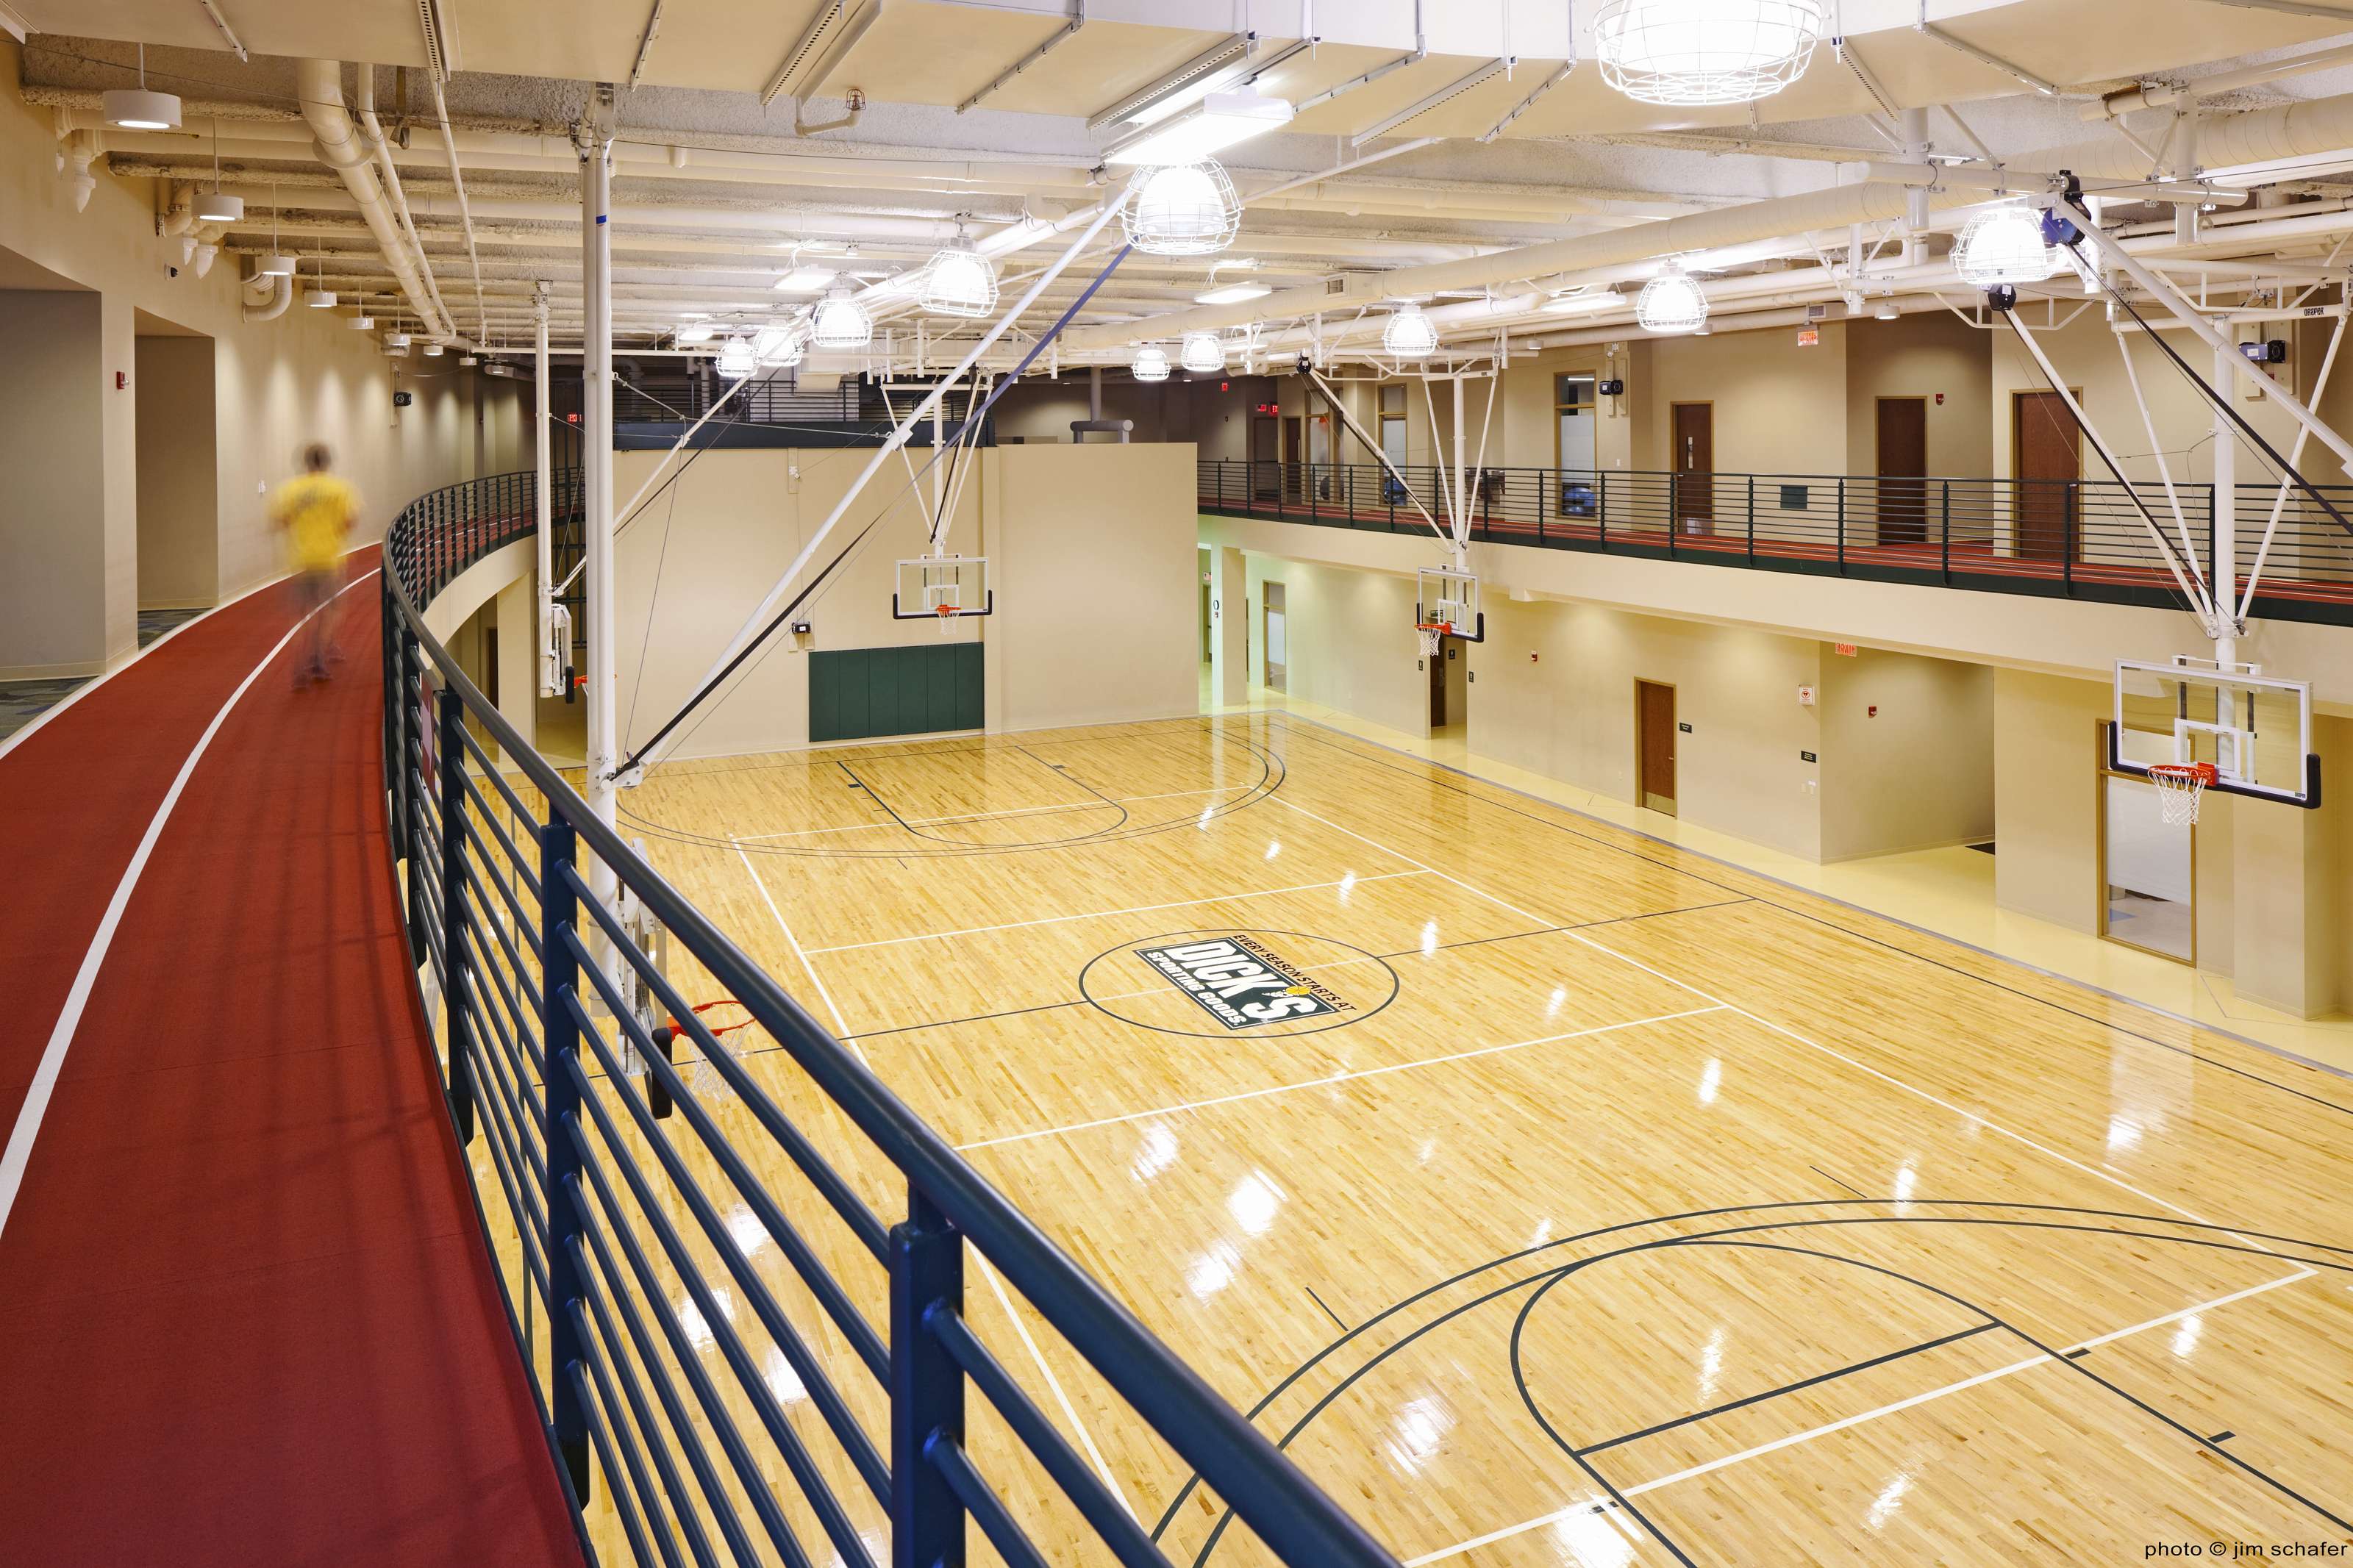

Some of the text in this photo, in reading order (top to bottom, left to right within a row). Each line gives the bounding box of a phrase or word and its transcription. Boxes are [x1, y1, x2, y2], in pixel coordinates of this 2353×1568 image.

[1146, 951, 1206, 992] SPORTING
[1163, 941, 1318, 1020] DICK'S
[1234, 934, 1357, 1012] EVERY SEASON STARTS AT
